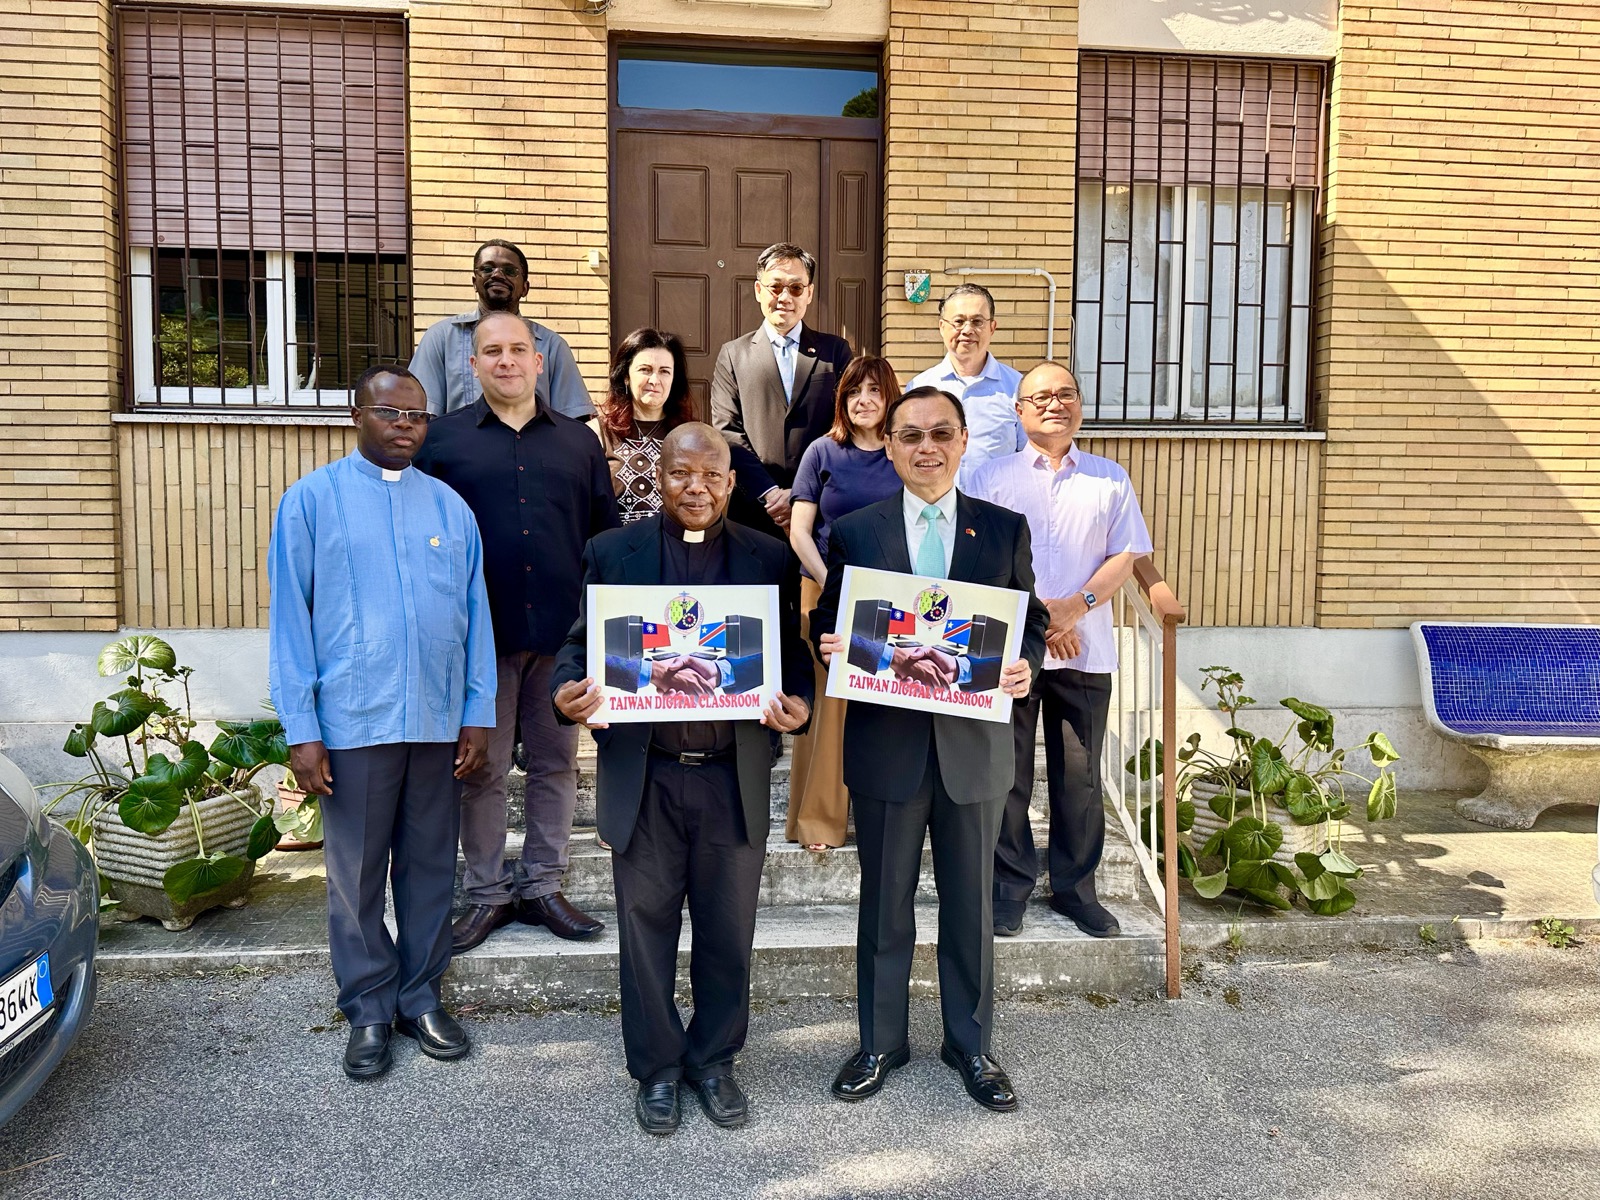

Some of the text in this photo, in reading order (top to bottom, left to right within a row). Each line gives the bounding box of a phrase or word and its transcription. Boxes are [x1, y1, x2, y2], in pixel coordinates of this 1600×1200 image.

[609, 693, 760, 710] TAIWAN DIGITAL CLASSROOM
[848, 674, 993, 709] TAIWAN DIGITAL CLASSROOM
